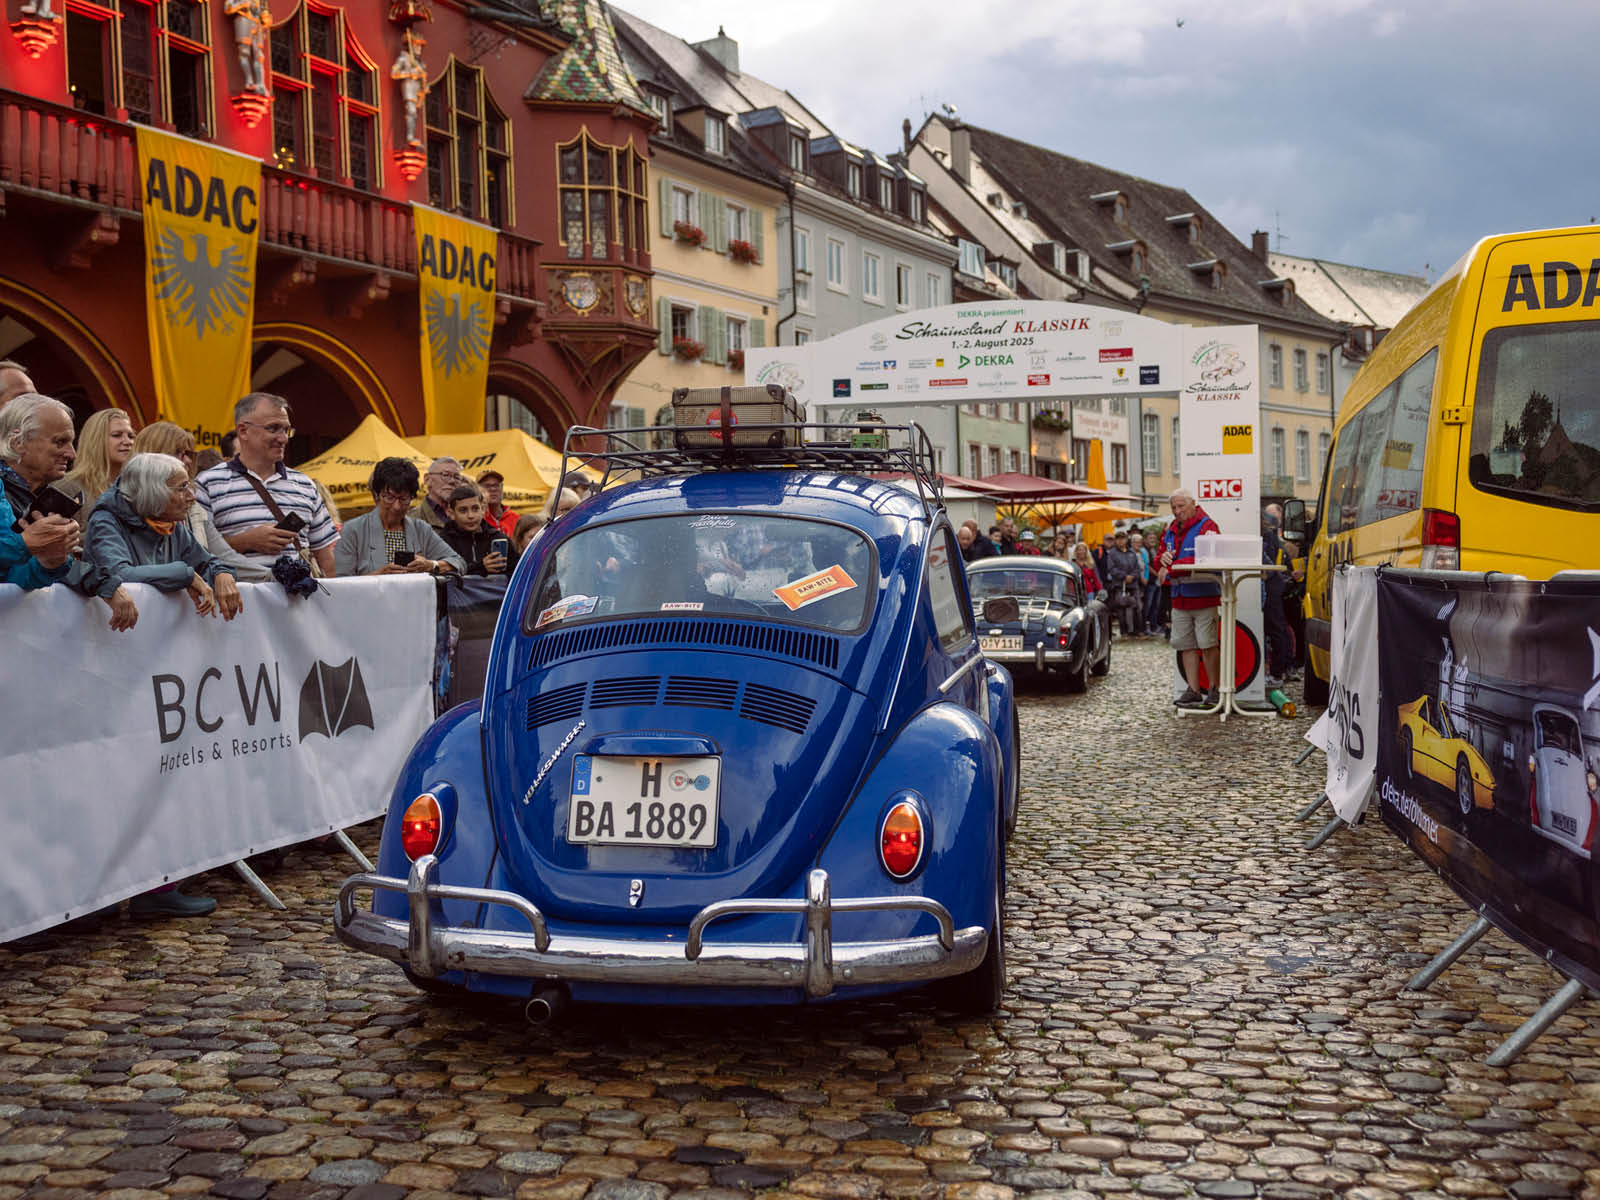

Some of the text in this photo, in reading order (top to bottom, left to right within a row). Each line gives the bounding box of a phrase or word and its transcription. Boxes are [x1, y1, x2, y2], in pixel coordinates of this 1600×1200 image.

[146, 158, 257, 234] ADAC
[421, 233, 494, 292] ADAC
[957, 310, 983, 318] DEKRA
[1014, 318, 1091, 334] KLASSIK
[974, 339, 1008, 350] August
[1010, 337, 1034, 347] 2025
[975, 354, 1014, 367] DEKRA
[1196, 392, 1241, 401] KLASSIK
[1223, 426, 1252, 437] ADAC
[1199, 480, 1241, 497] FMC
[152, 661, 281, 744] BCW
[160, 732, 292, 774] Hotels & Resorts
[523, 719, 586, 805] VOLKSWAGEN
[577, 779, 586, 791] D
[640, 762, 662, 798] H
[575, 801, 707, 840] BA 1889
